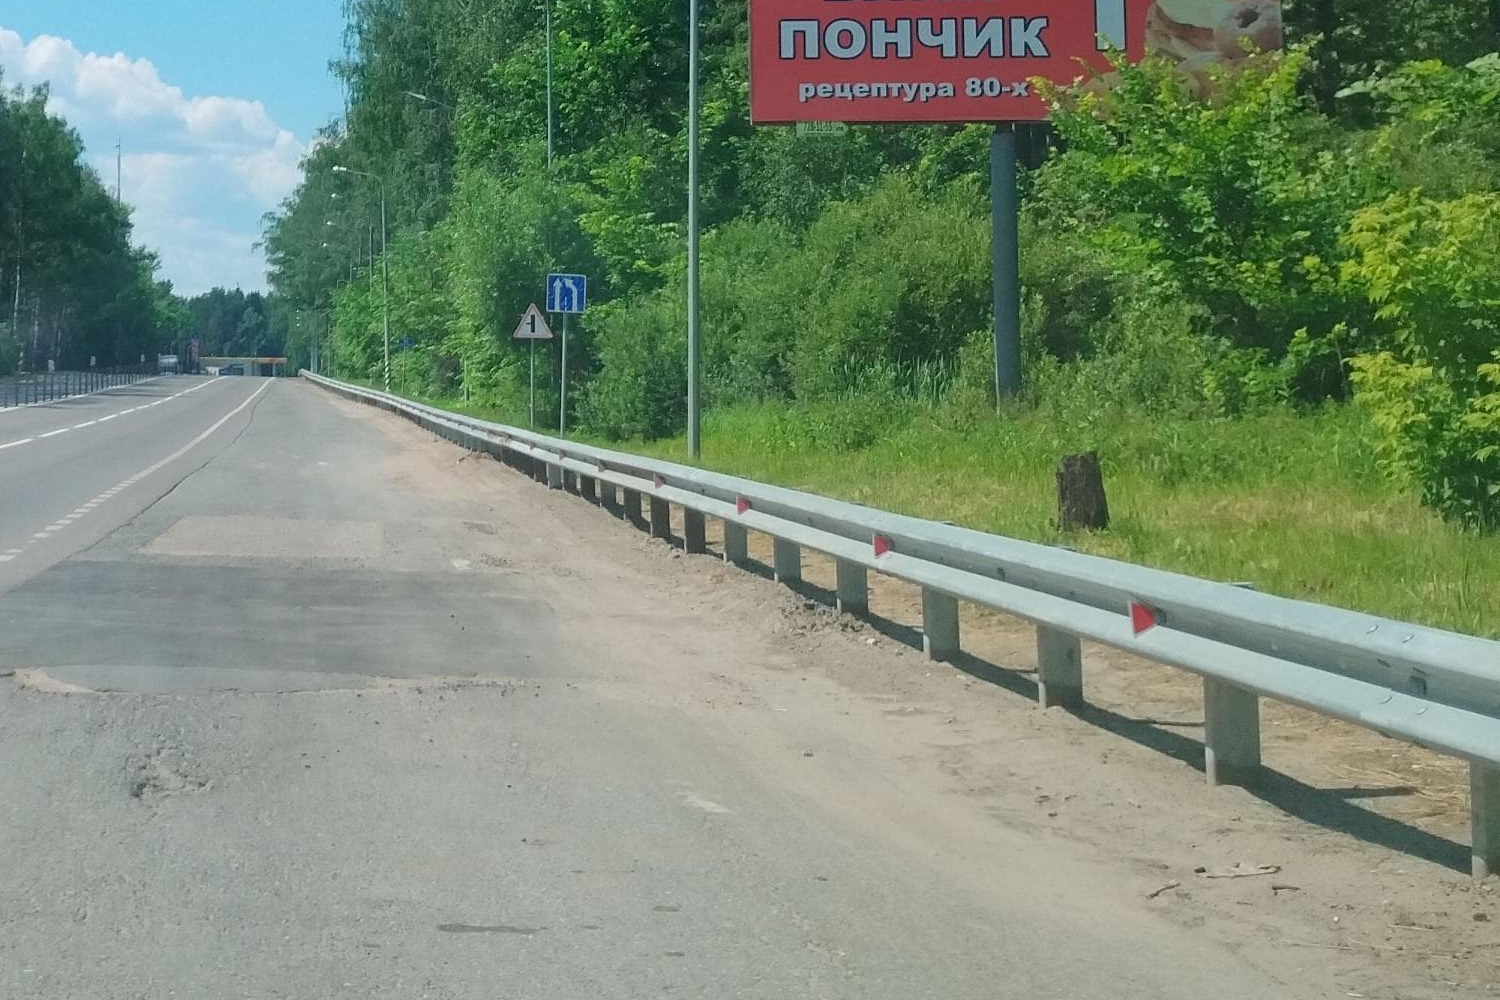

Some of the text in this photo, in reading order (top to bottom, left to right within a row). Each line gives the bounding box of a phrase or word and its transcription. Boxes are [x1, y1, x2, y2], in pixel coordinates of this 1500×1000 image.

[779, 16, 1051, 59] ПОНЧИК
[799, 77, 1029, 102] рецептура 80-х
